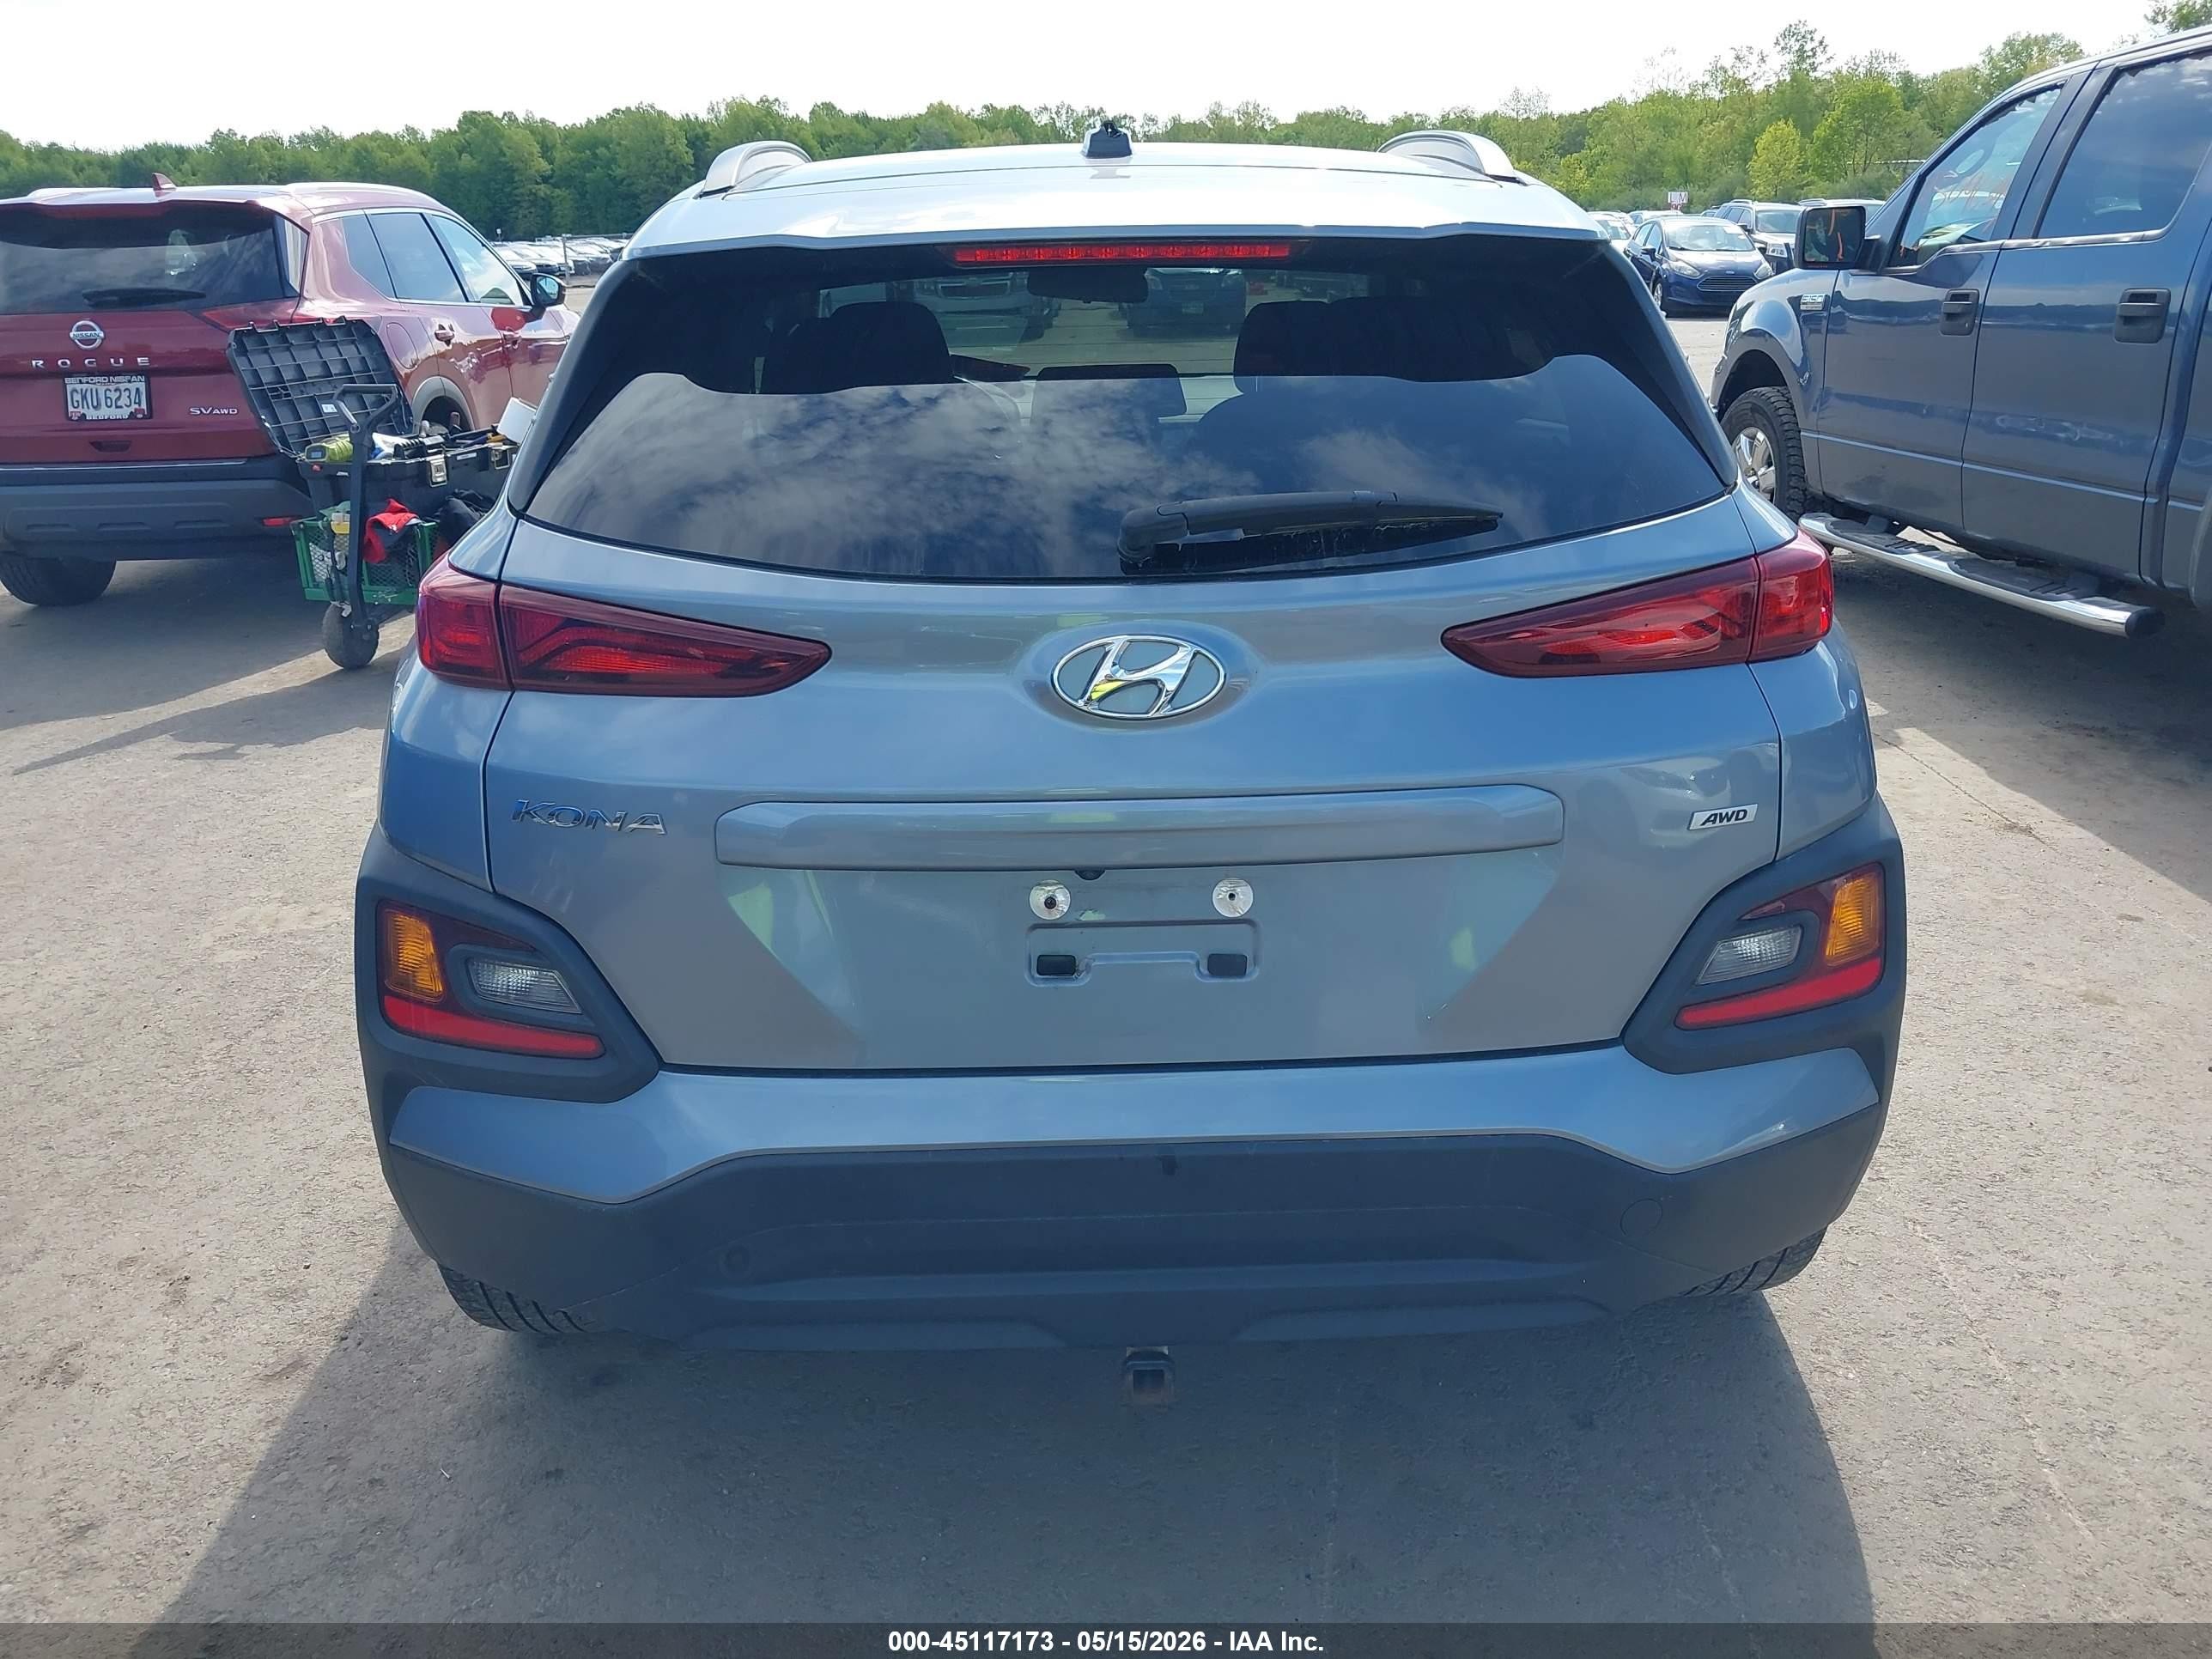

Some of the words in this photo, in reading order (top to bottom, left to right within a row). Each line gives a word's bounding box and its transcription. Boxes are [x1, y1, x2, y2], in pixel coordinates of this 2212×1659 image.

[31, 356, 150, 368] ROGUE
[70, 387, 100, 410] GKU
[104, 387, 142, 409] 6234
[510, 798, 668, 836] KONA
[1699, 808, 1748, 827] AWD
